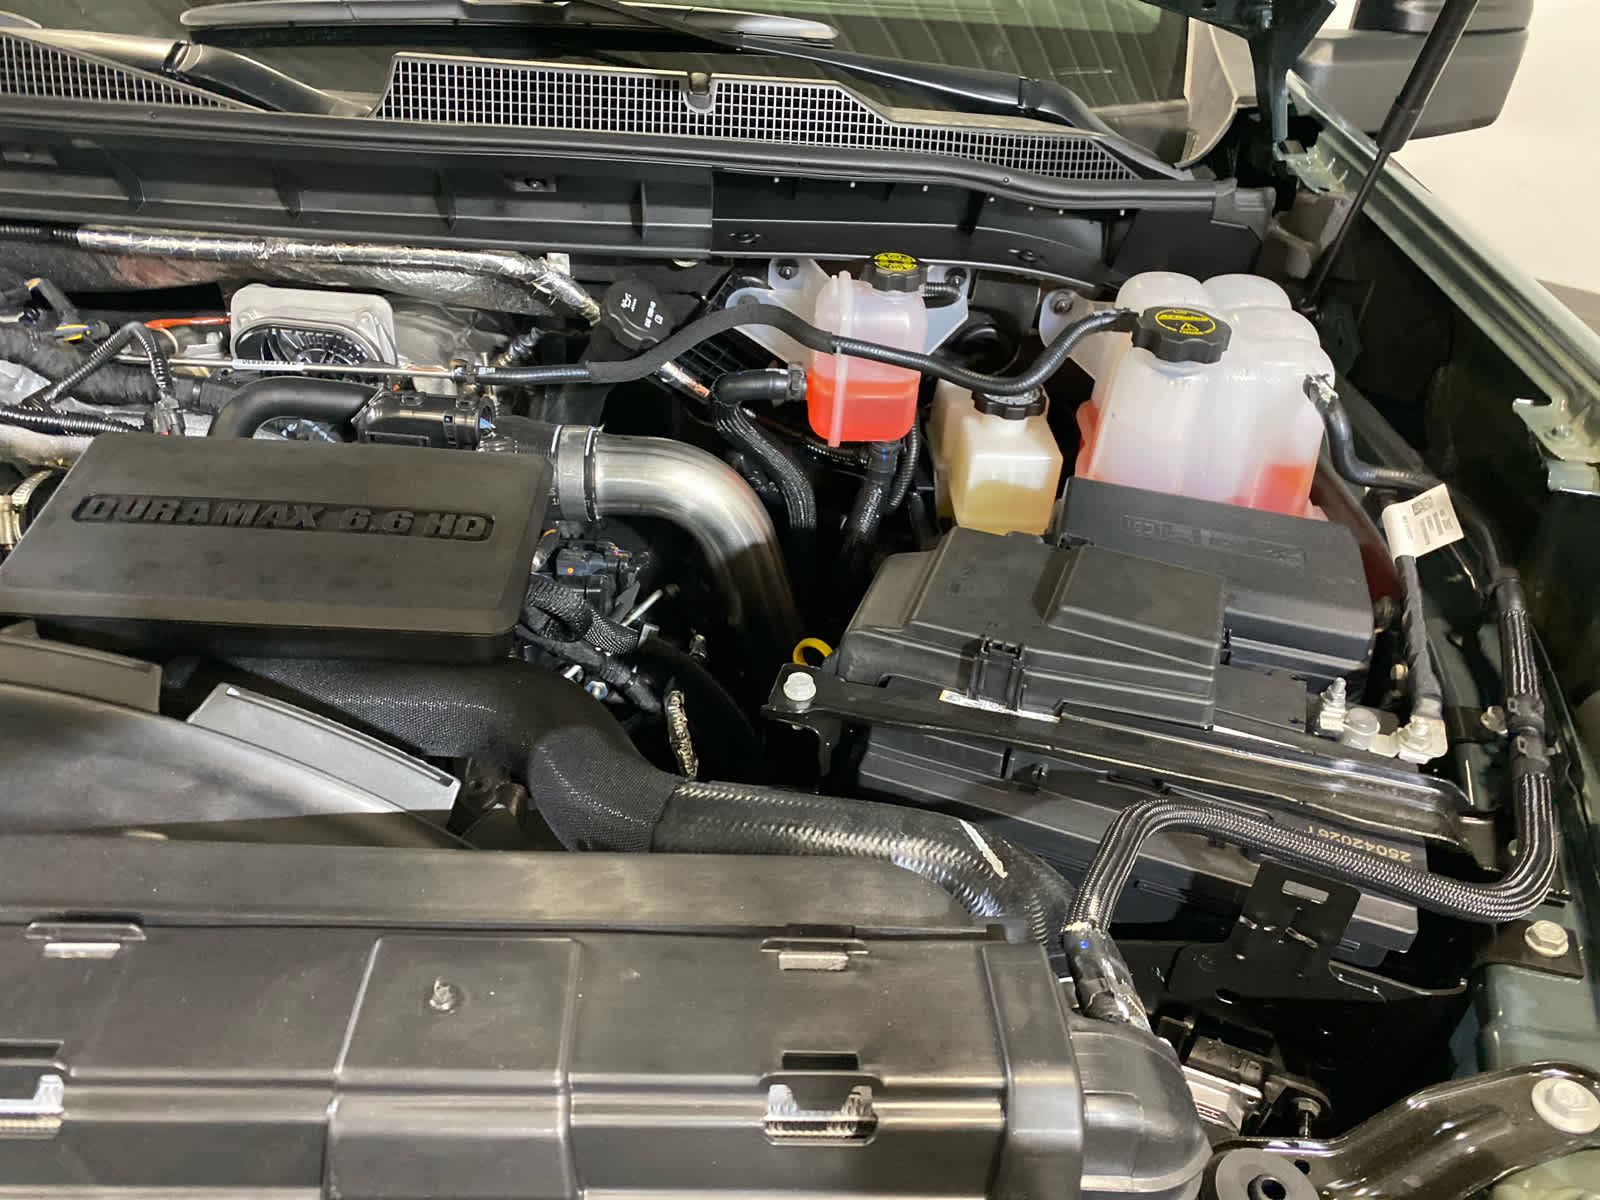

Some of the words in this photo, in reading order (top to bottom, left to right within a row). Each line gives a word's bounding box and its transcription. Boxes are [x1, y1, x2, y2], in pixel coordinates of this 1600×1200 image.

[78, 496, 325, 530] DURAMAX
[339, 507, 415, 534] 6.6
[423, 511, 487, 538] HD
